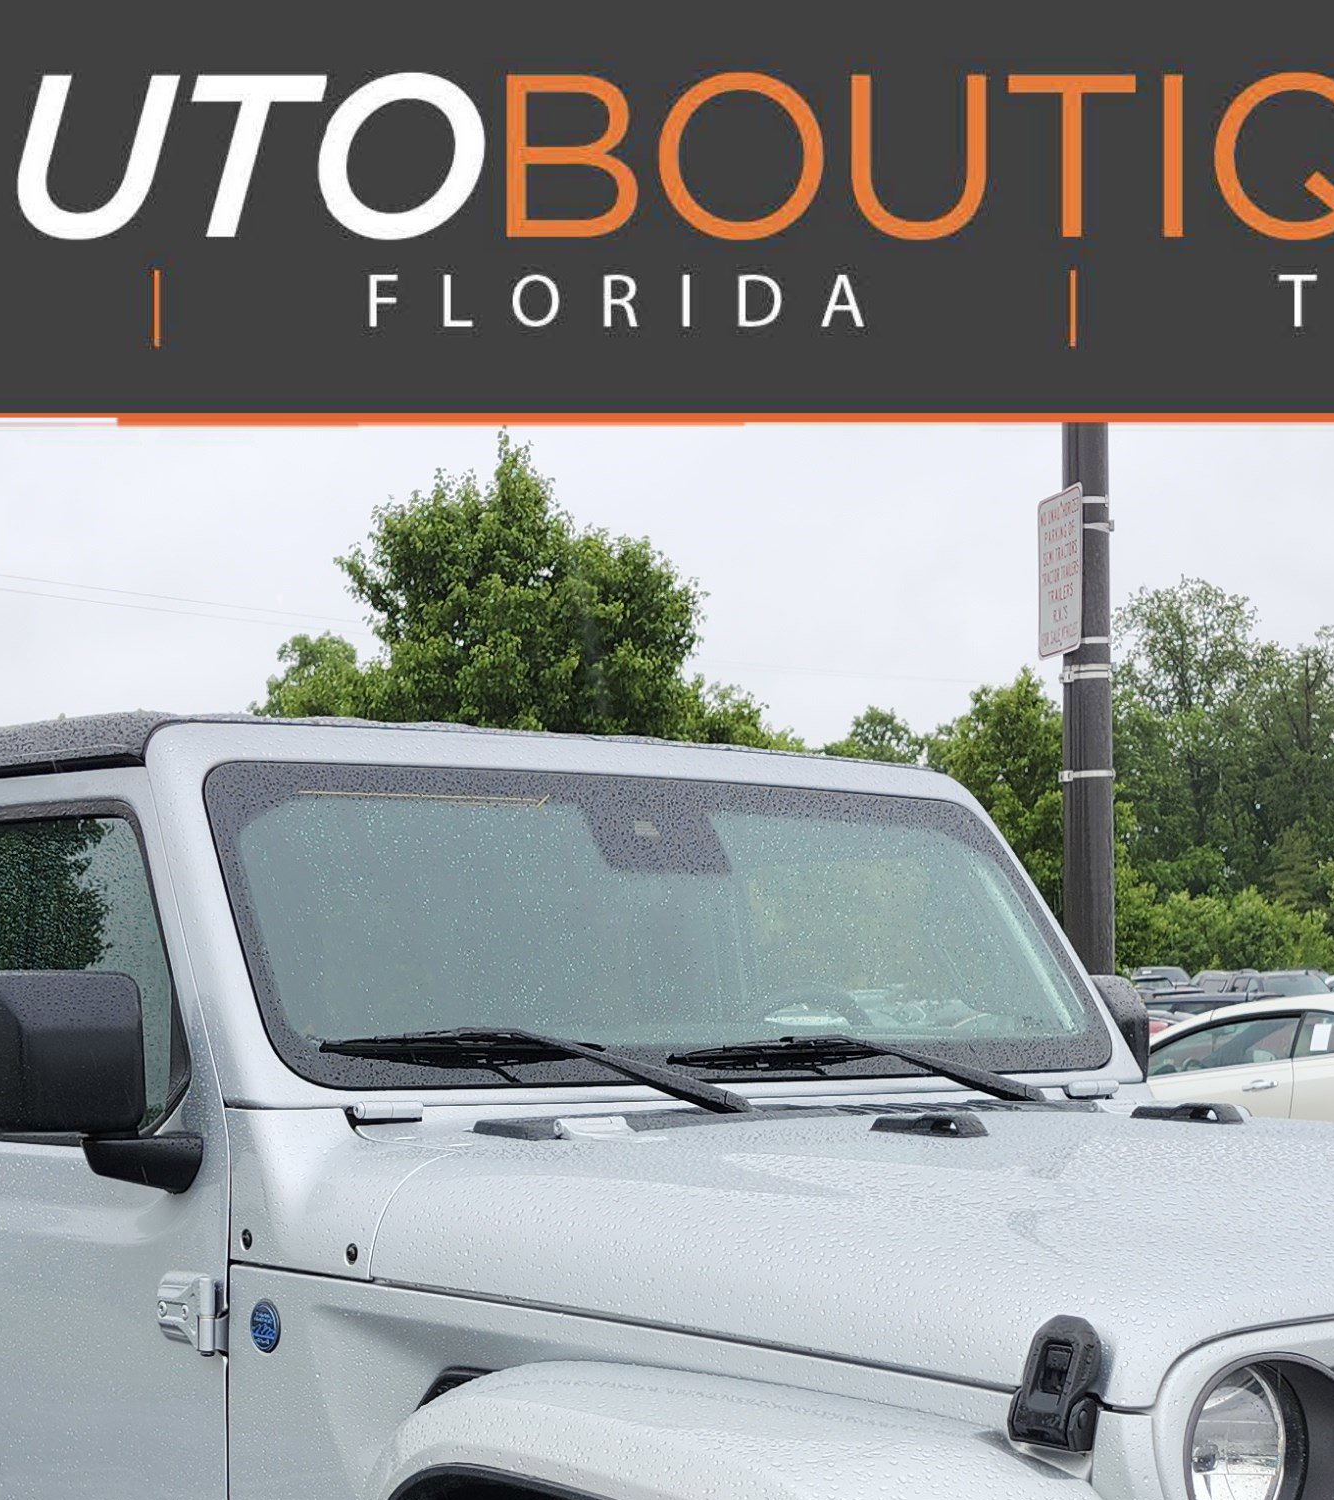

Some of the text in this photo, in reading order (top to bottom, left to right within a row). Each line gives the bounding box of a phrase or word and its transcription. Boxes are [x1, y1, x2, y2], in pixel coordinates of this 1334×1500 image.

[1044, 518, 1075, 544] PARKING OF
[1043, 539, 1078, 568] SEMI TRACTORS
[1047, 582, 1073, 604] TRAILERS
